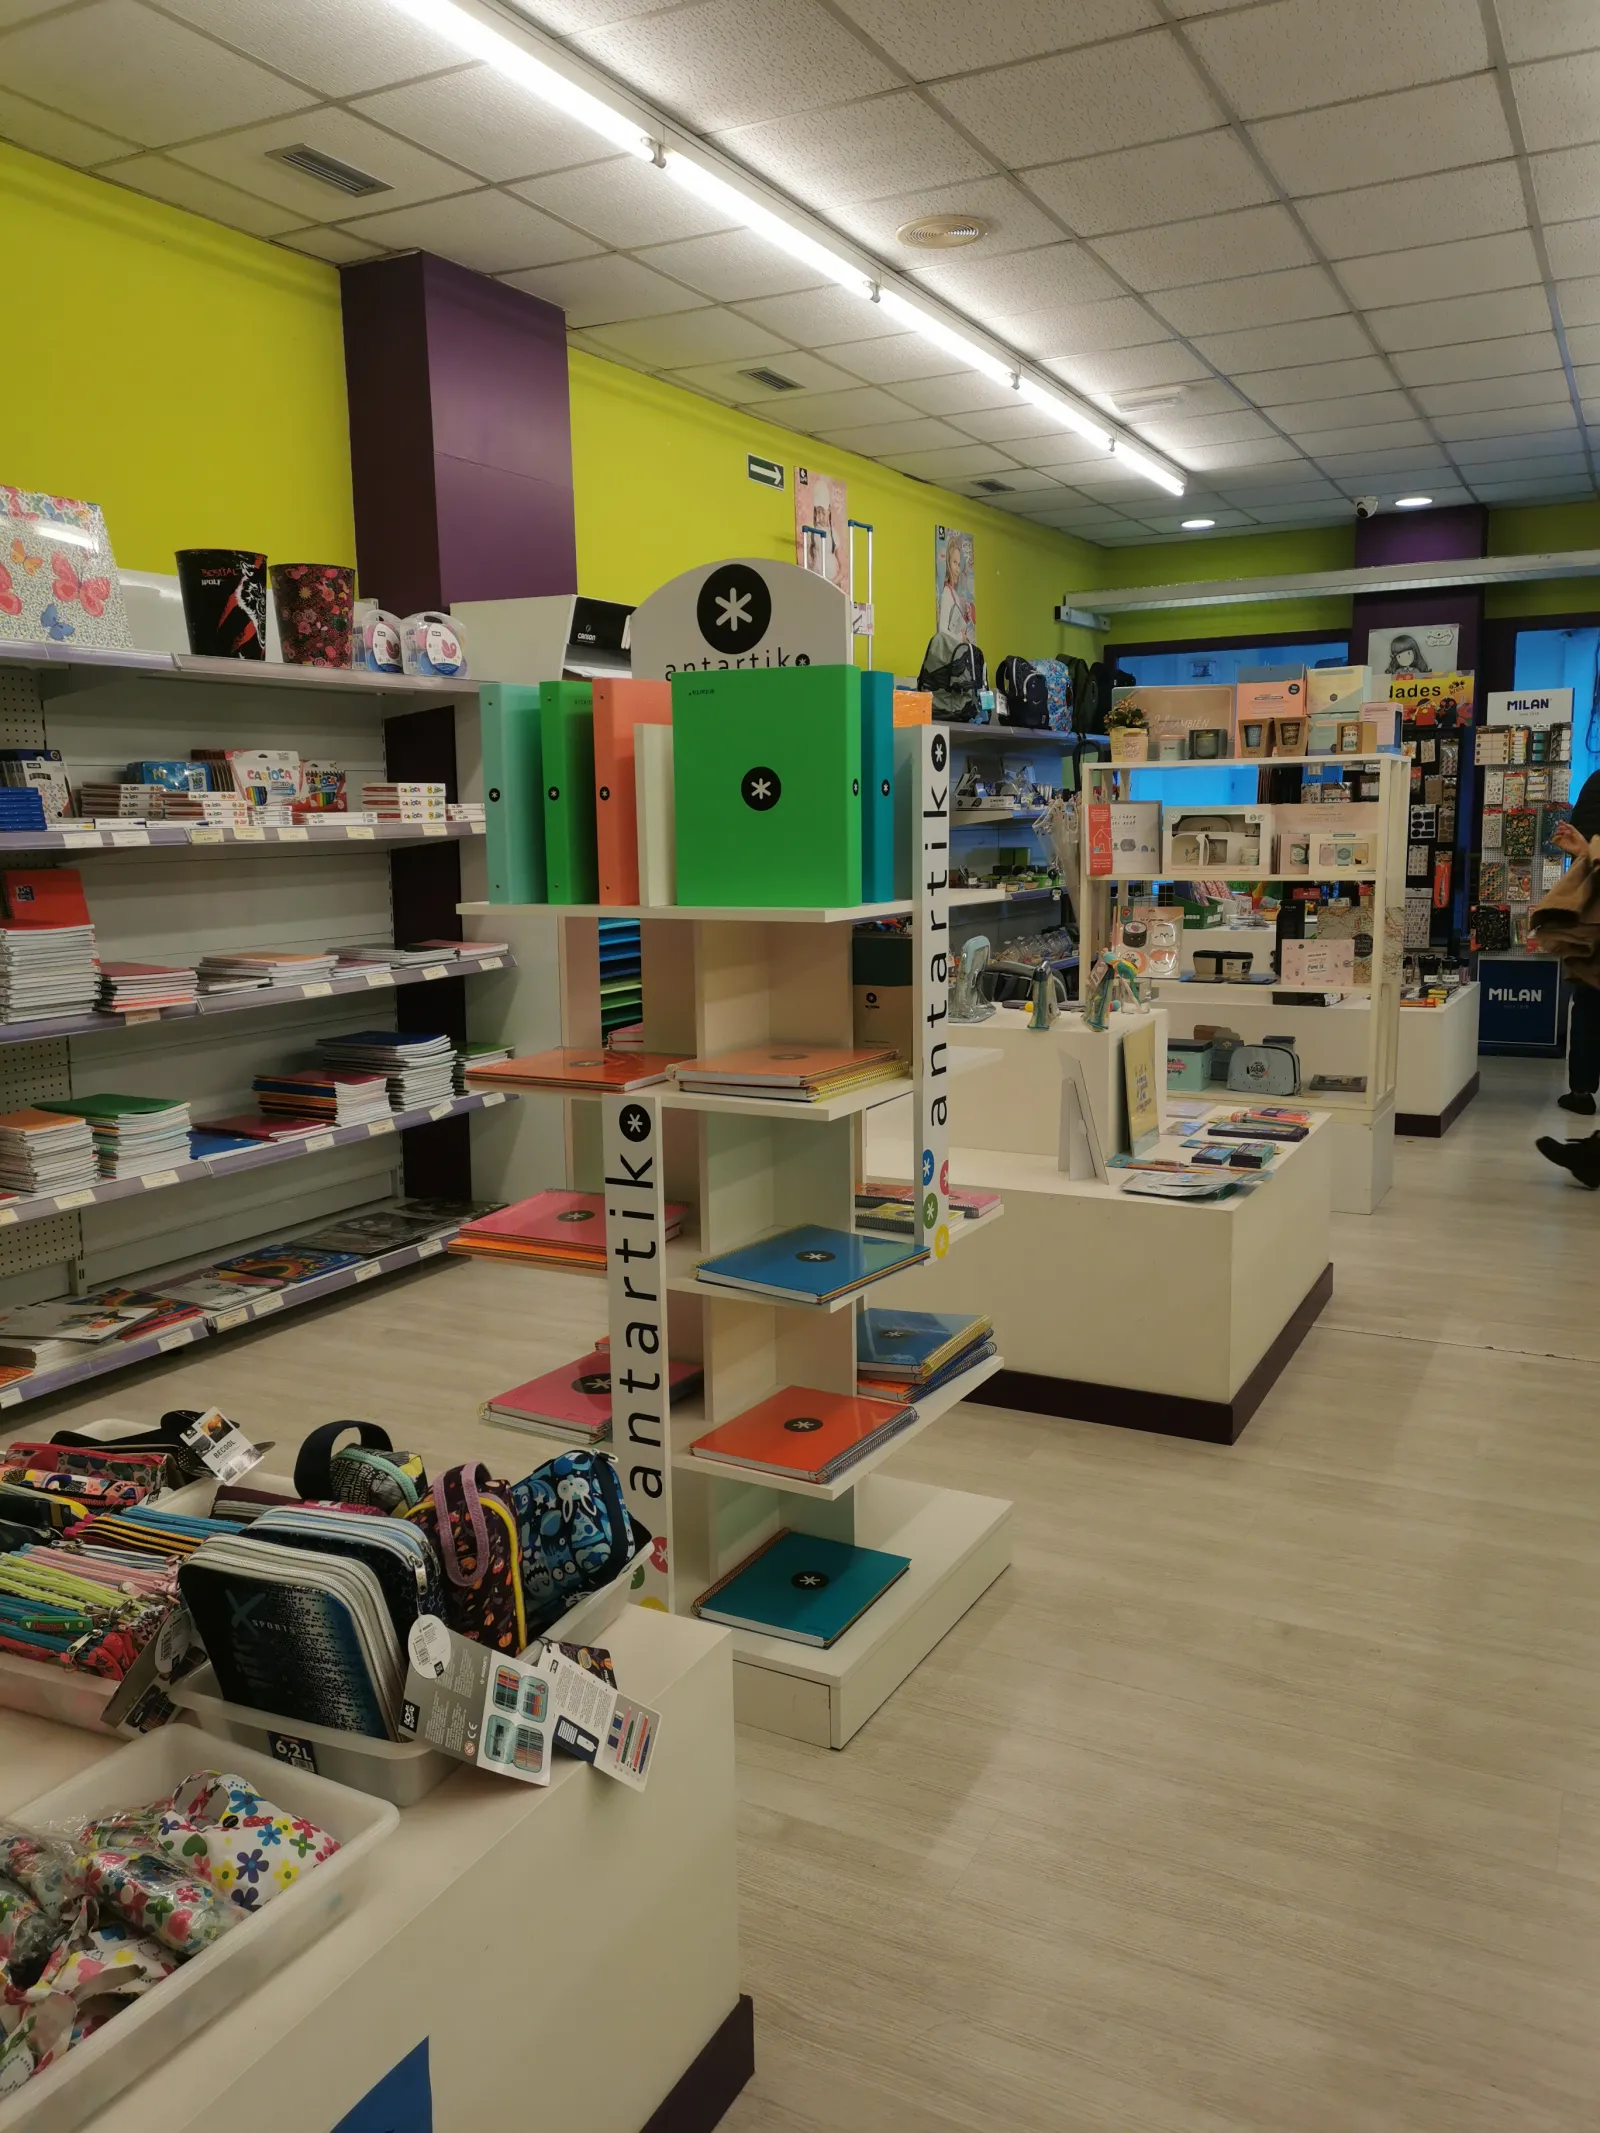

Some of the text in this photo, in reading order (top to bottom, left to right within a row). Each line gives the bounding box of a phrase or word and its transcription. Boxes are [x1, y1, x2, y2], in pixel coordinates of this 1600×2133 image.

[201, 567, 237, 577] BESTIAL
[1507, 698, 1549, 711] MILAN
[247, 766, 292, 781] CARIOCA
[1488, 988, 1542, 1002] MILAN
[213, 1439, 237, 1460] BECOOL
[251, 1618, 296, 1635] SPORTS
[275, 1740, 312, 1761] 6,2L
